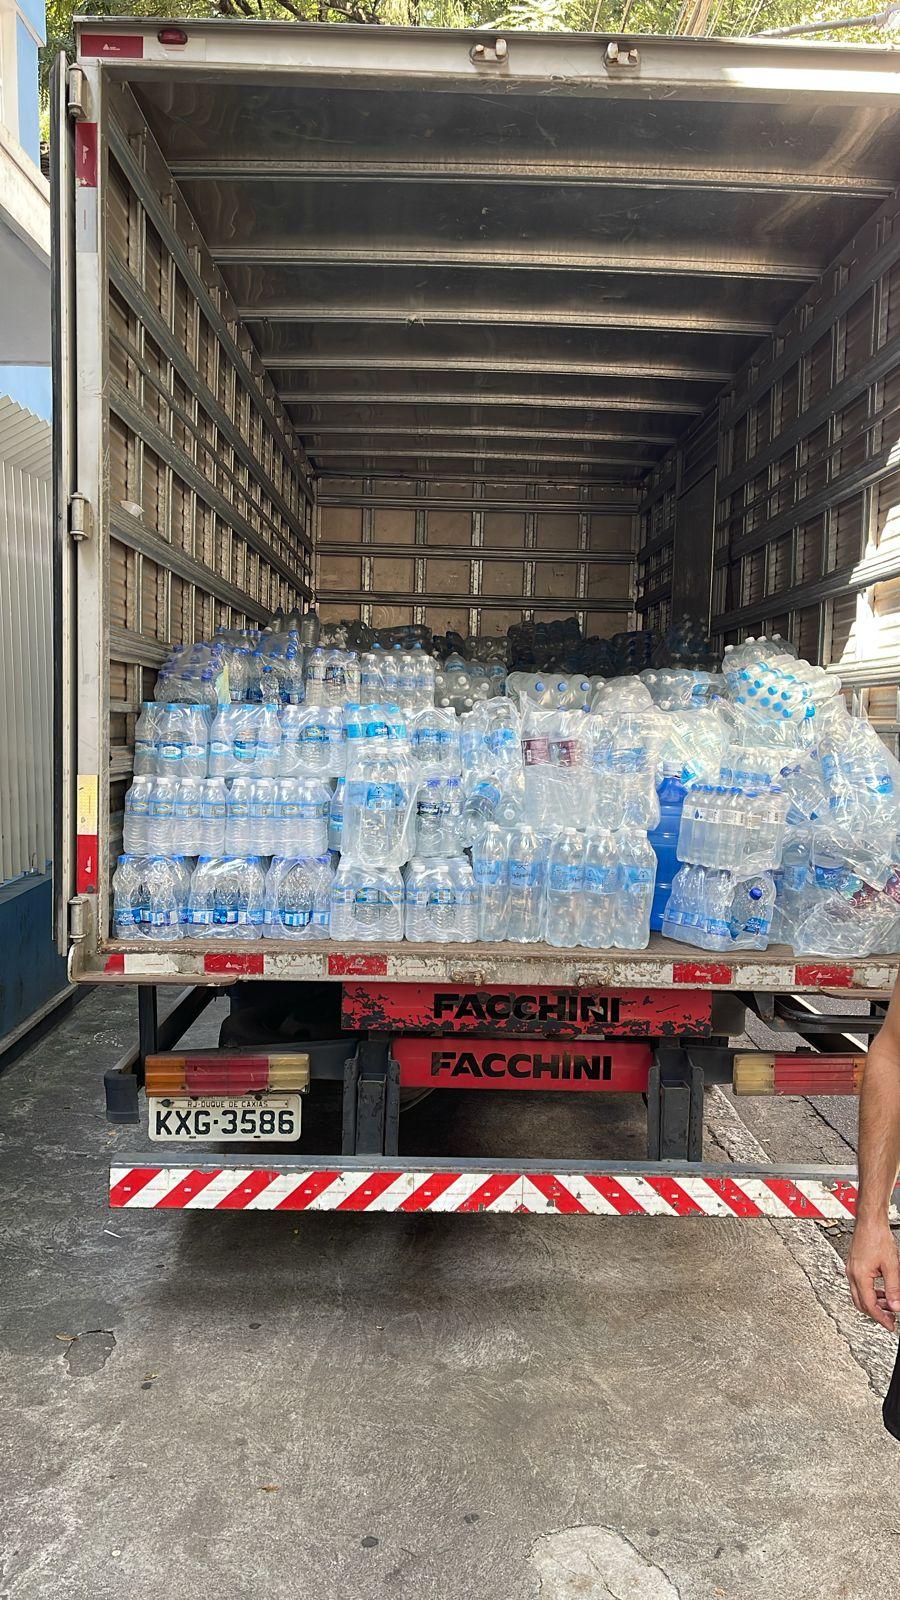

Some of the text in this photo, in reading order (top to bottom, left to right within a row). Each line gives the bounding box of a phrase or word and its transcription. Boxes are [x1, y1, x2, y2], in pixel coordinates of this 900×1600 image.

[433, 993, 620, 1023] FACCHINI
[430, 1051, 612, 1081] FACCHINI
[228, 1100, 239, 1108] DE
[241, 1100, 269, 1108] CAXIAS
